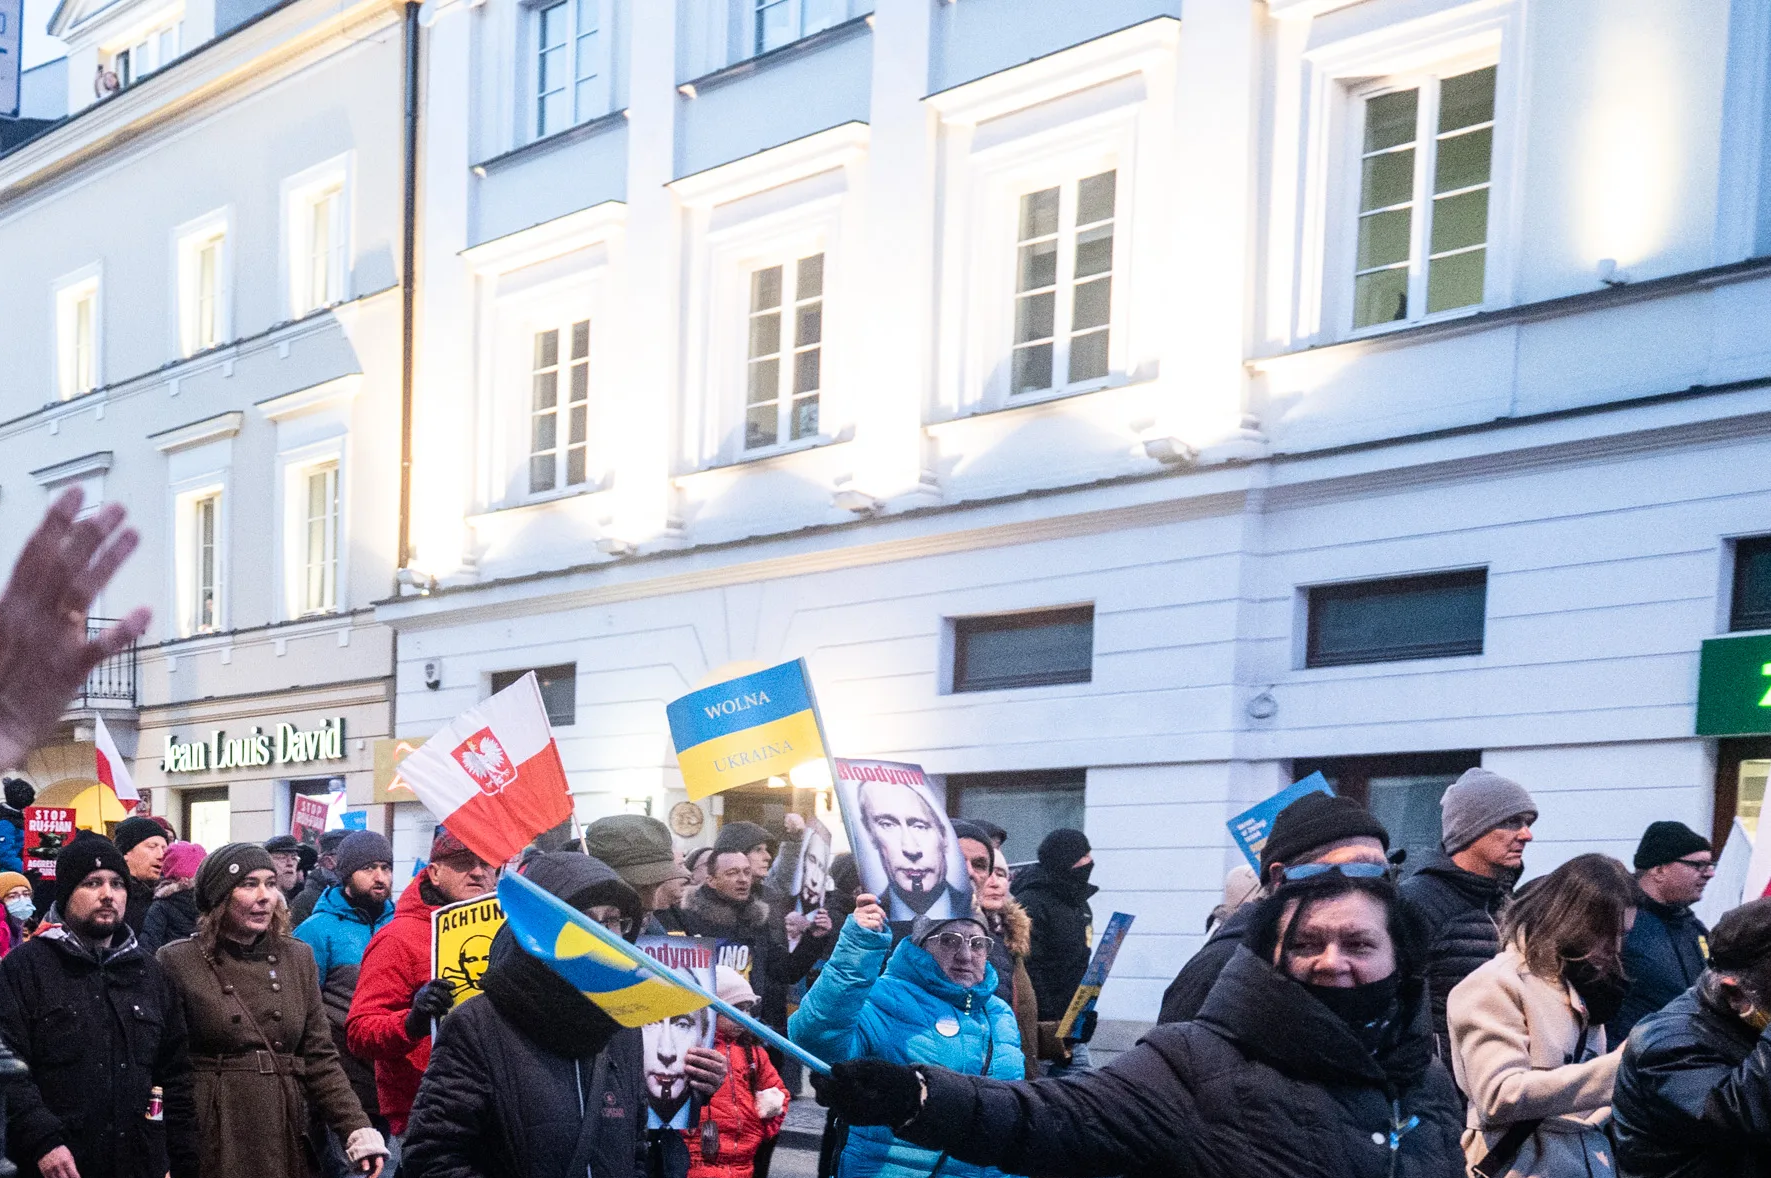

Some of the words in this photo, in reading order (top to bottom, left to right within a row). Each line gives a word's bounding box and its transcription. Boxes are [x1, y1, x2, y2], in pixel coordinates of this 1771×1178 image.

[704, 690, 772, 720] WOLNA
[161, 734, 207, 773] Jean
[209, 726, 271, 769] Louis
[275, 716, 344, 764] David
[714, 740, 795, 773] UKRAINA
[35, 809, 67, 821] STOP
[301, 801, 323, 816] STOP
[28, 820, 73, 833] RUSSIAN
[442, 902, 505, 934] ACHTUN
[636, 943, 713, 970] odymir
[718, 945, 749, 971] INO
